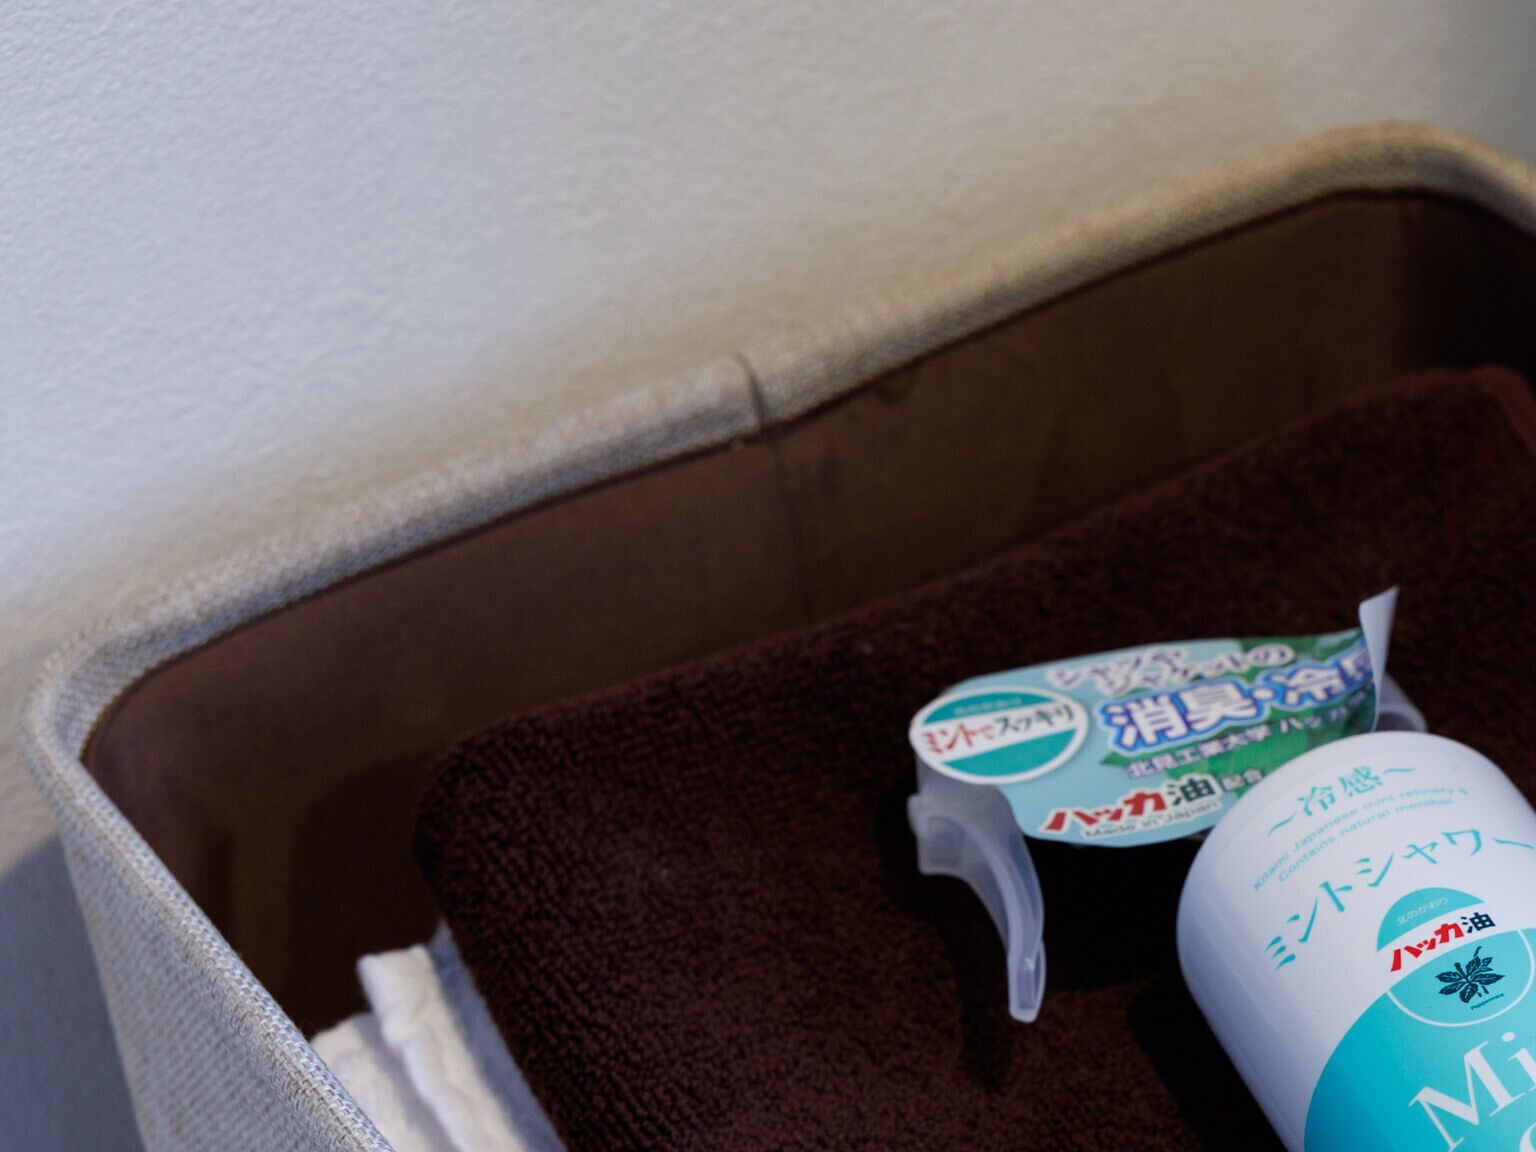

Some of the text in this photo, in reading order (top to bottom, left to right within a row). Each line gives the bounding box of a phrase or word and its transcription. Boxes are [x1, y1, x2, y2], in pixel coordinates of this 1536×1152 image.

[922, 703, 1076, 753] ミントでスッキリ
[1042, 776, 1216, 831] ハッカ油
[1084, 823, 1137, 838] Made
[1163, 801, 1219, 824] Japan
[1253, 853, 1290, 891] Kitami
[1294, 807, 1359, 852] Japanese
[1362, 794, 1395, 810] mint
[1278, 797, 1454, 882] Contains natural menthol
[1265, 828, 1536, 971] ミントシャワー
[1390, 911, 1496, 972] ハッカ油
